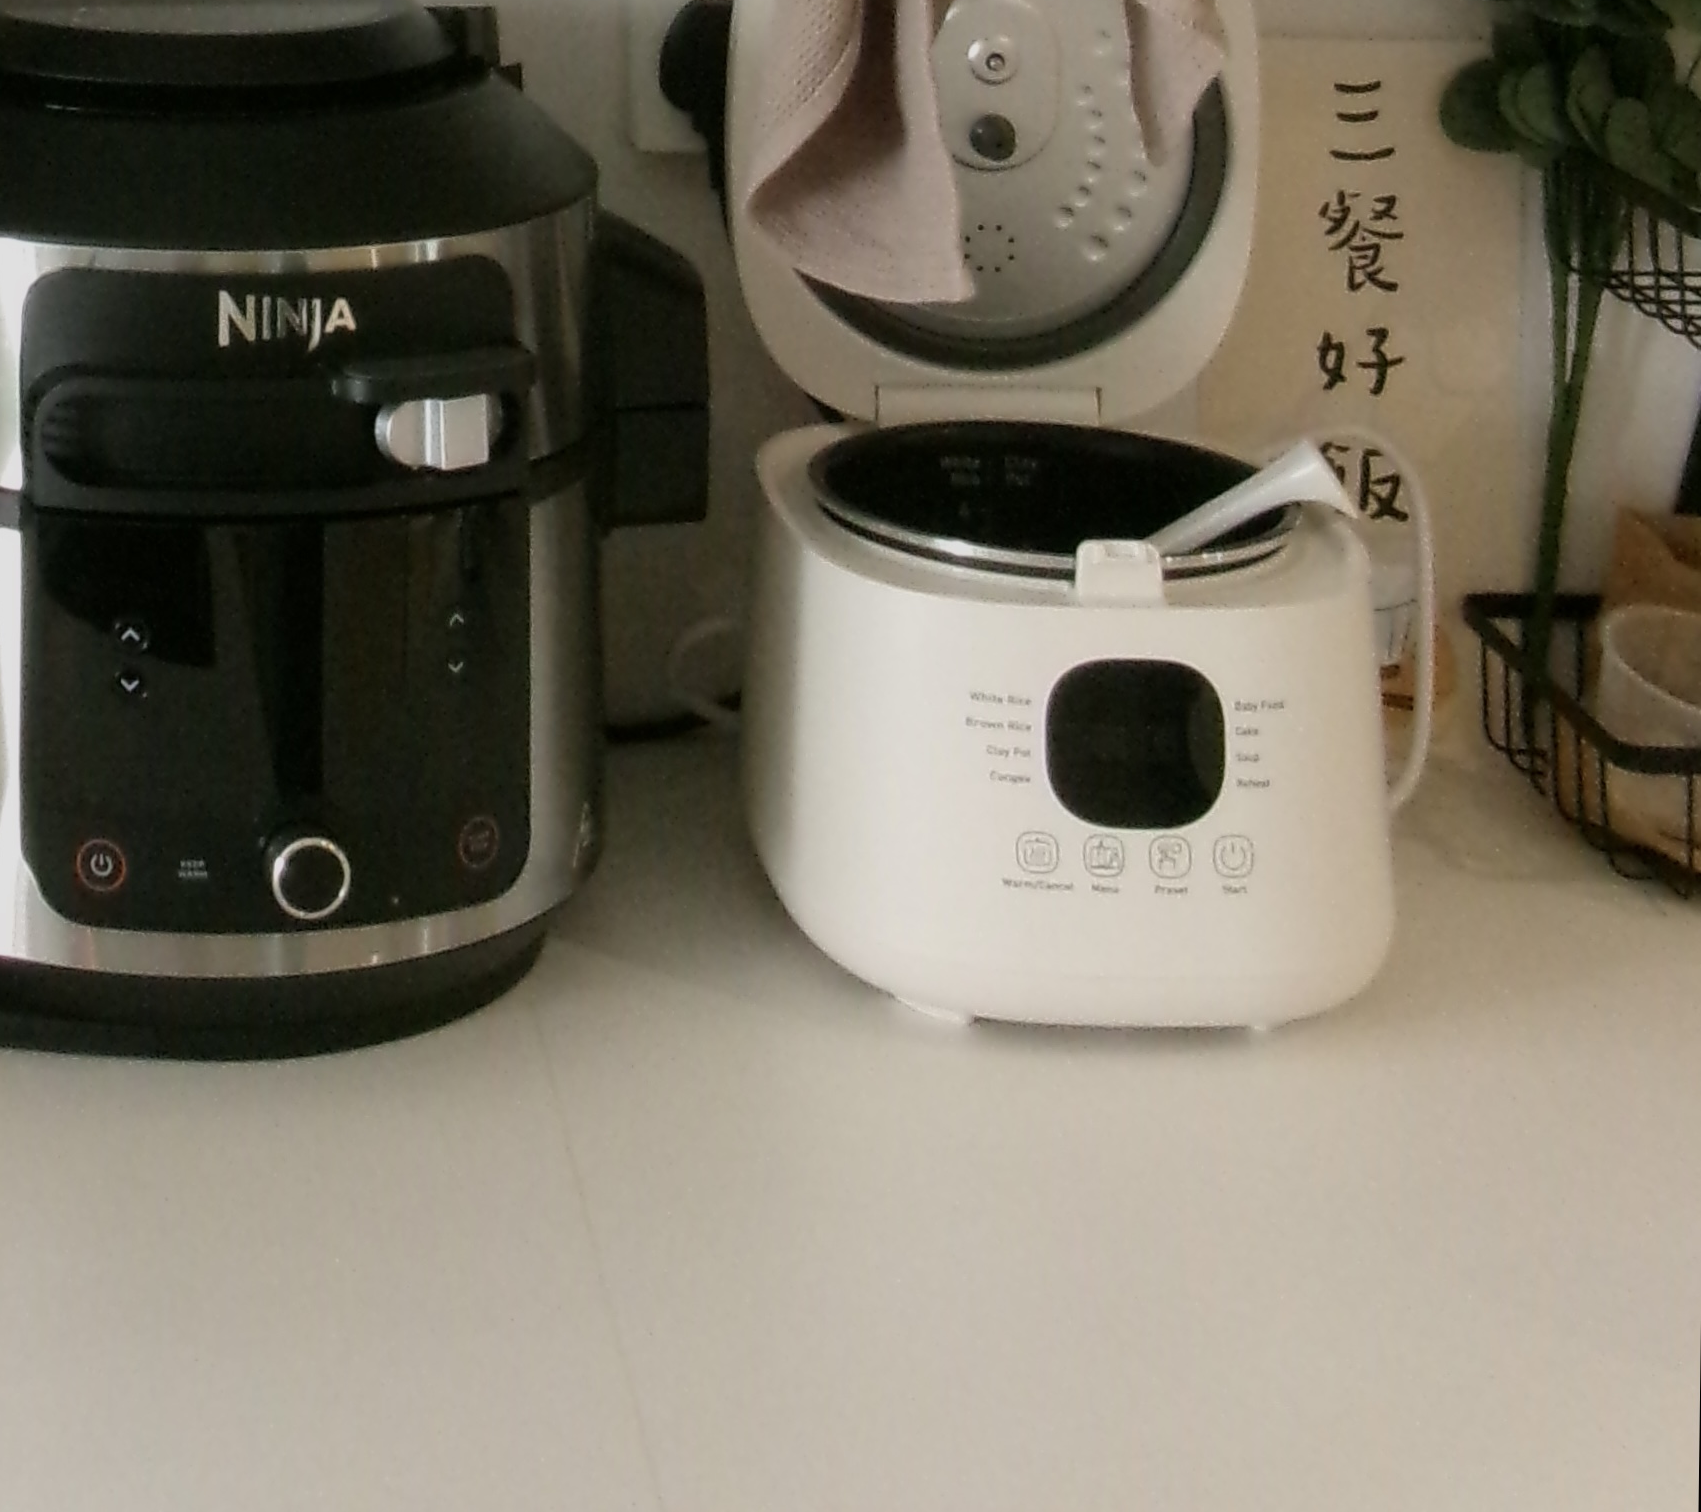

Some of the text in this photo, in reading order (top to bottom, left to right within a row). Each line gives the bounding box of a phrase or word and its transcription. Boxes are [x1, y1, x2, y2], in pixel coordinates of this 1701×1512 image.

[218, 289, 357, 352] NINJA
[969, 691, 1032, 706] White Rice
[965, 716, 1032, 732] Brown Rice
[986, 744, 1009, 758] Clay
